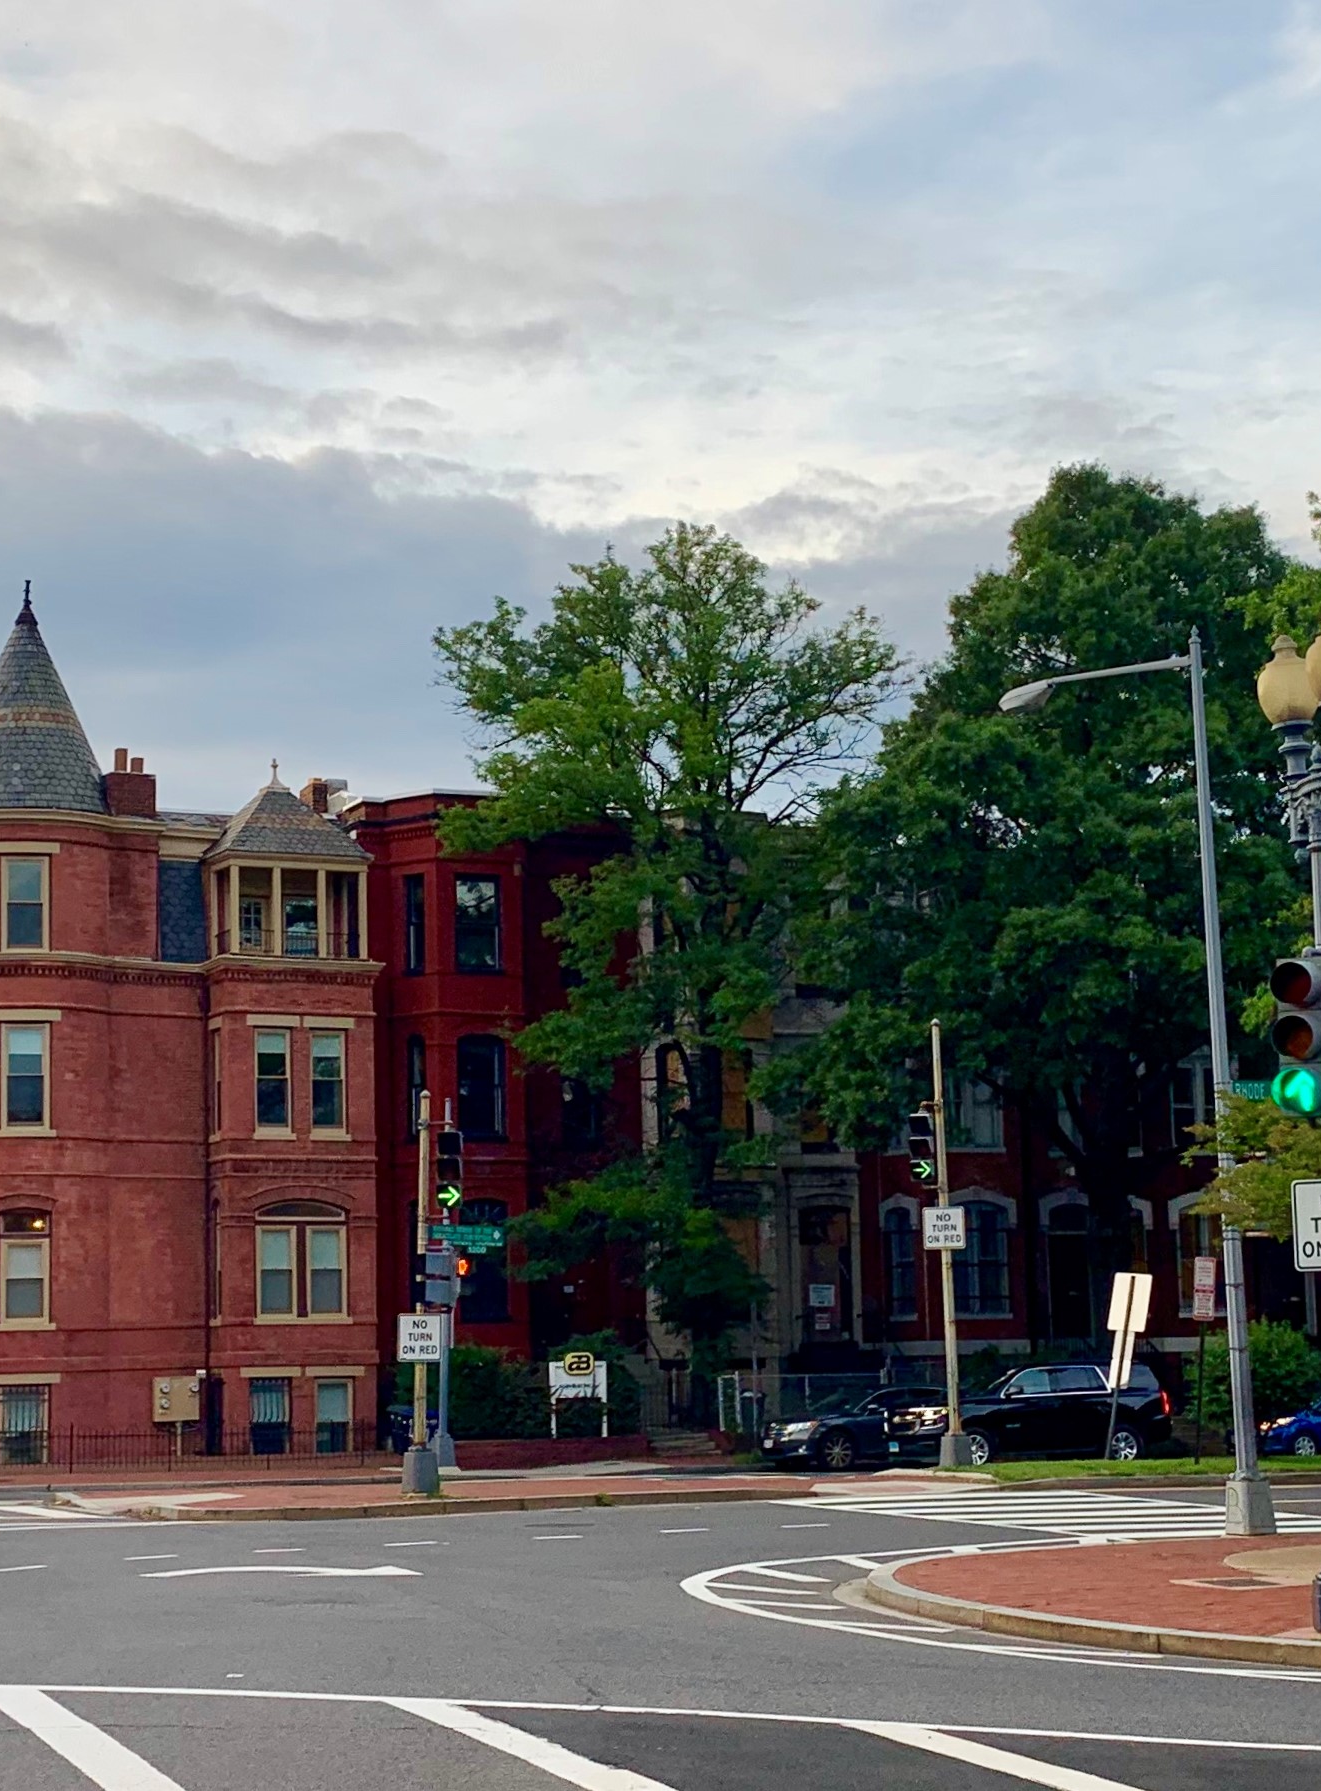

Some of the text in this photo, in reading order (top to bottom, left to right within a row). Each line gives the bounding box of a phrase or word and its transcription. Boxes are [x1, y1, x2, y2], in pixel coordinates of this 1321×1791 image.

[1234, 1083, 1265, 1100] RHODE
[935, 1213, 951, 1222] NO
[931, 1224, 957, 1233] TURN
[927, 1234, 962, 1244] ON RED
[412, 1320, 428, 1329] NO
[408, 1332, 433, 1342] TURN
[402, 1345, 438, 1355] ON RED
